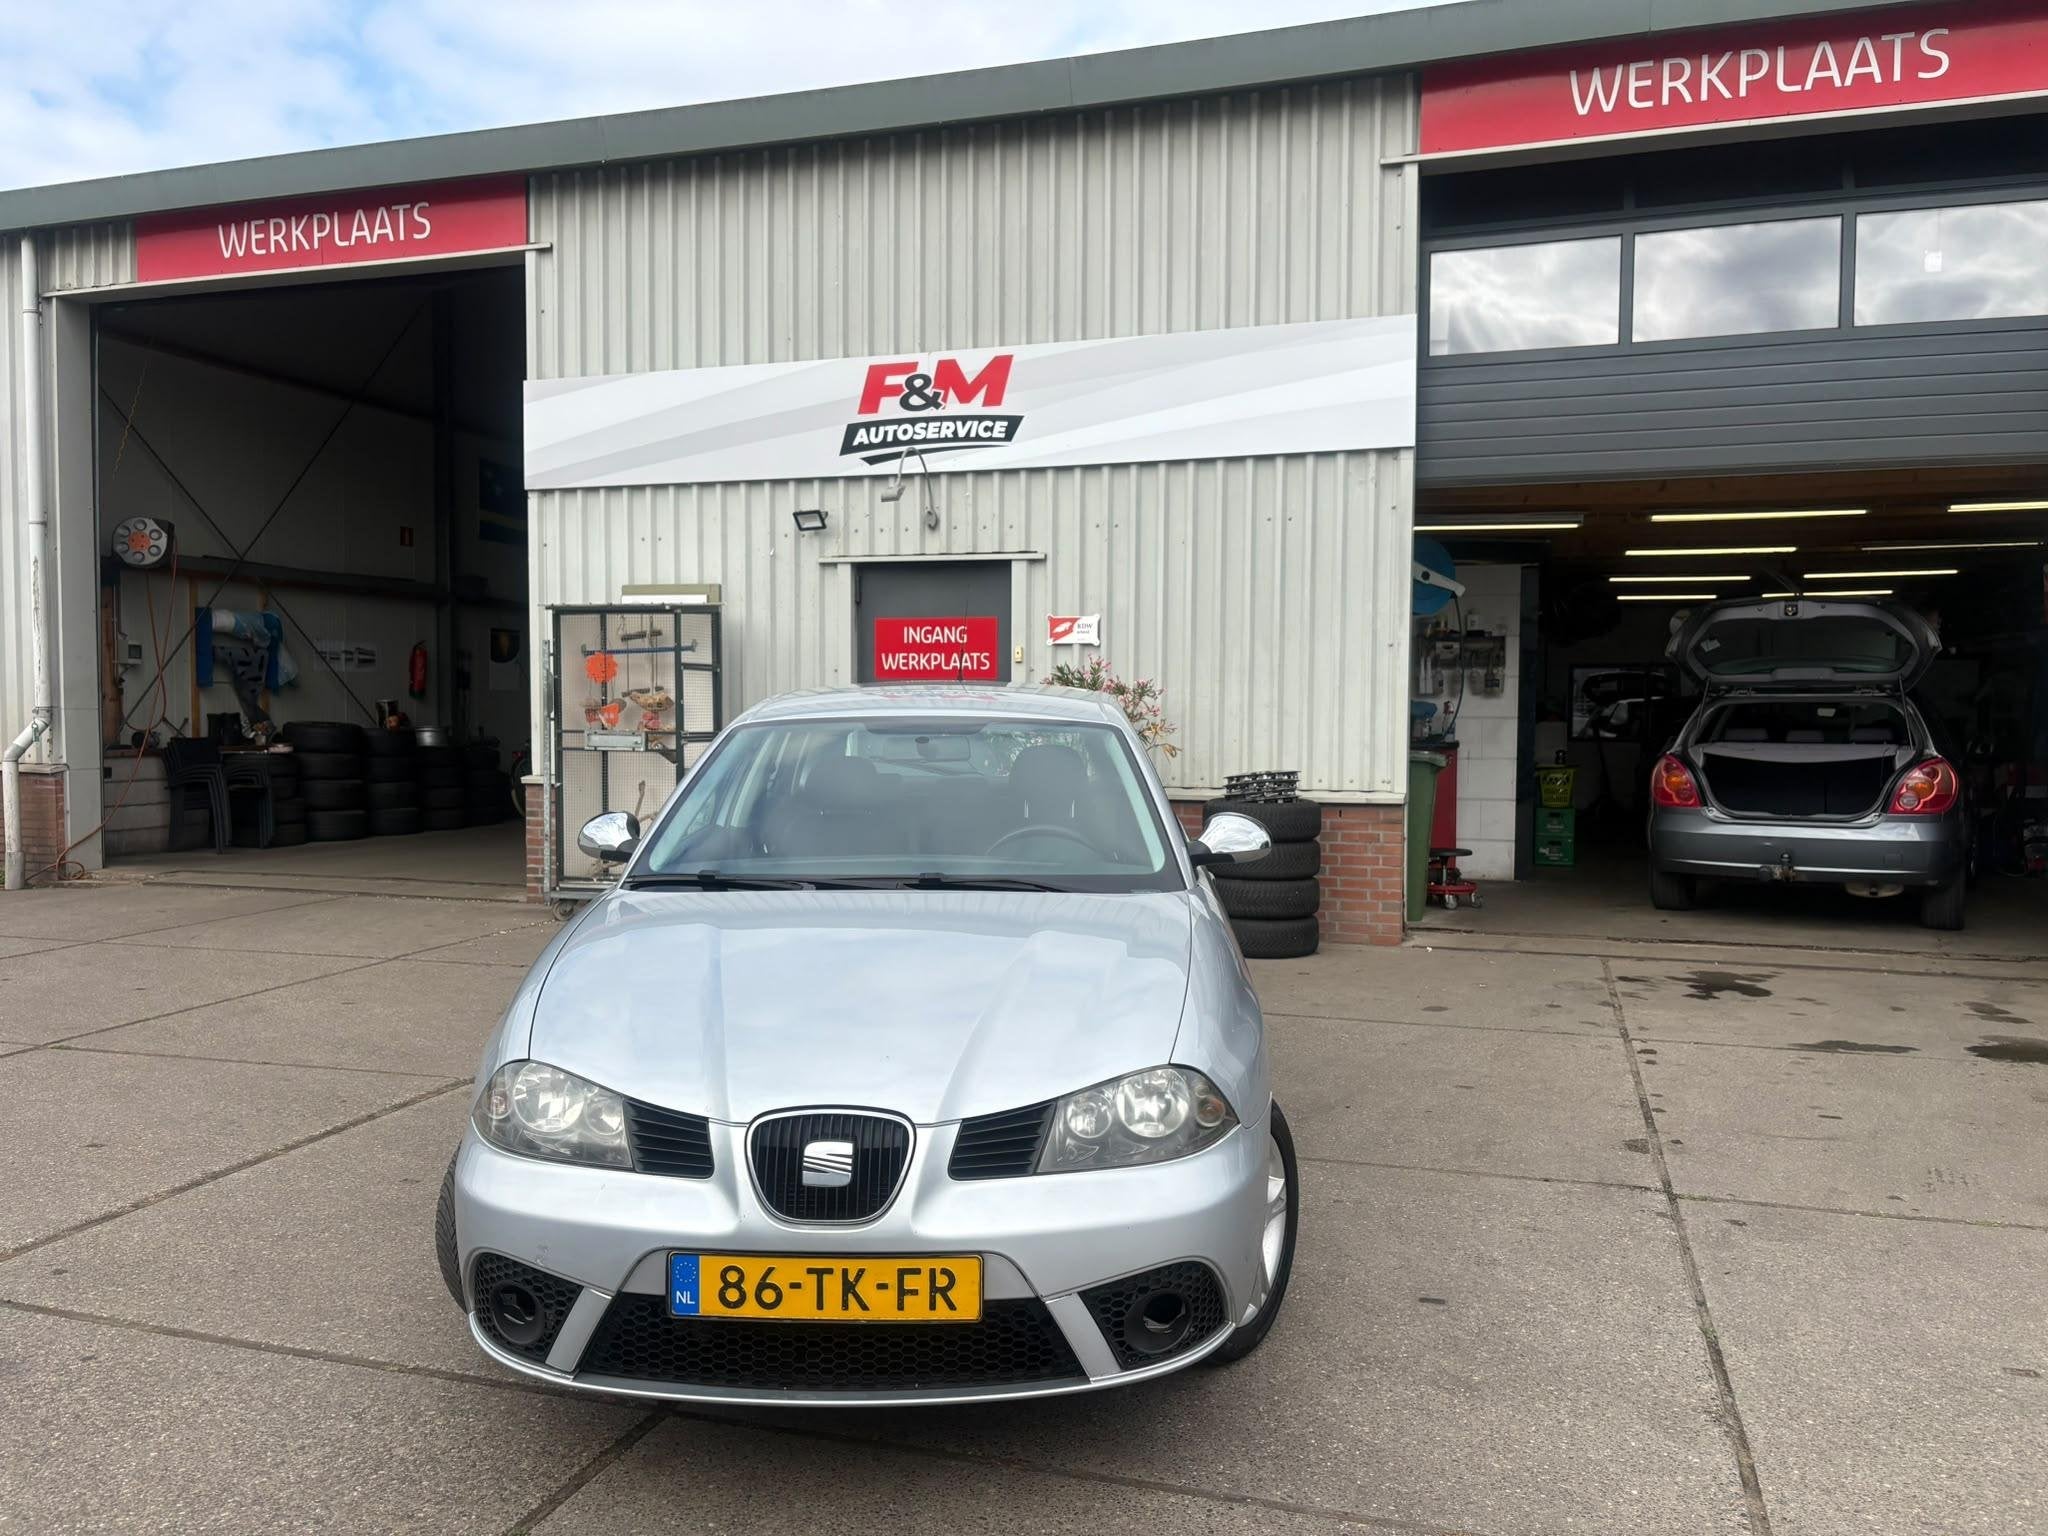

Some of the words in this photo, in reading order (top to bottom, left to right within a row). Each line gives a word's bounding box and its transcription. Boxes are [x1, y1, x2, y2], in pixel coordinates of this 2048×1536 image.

[1569, 28, 1950, 115] WERKPLAATS
[218, 202, 431, 259] WERKPLAATS
[857, 354, 1014, 414] F&M
[852, 420, 1008, 446] AUTOSERVICE
[903, 626, 968, 644] INGANG
[881, 652, 991, 671] WERKPLAATS
[676, 1290, 695, 1305] NL
[718, 1264, 957, 1312] 86-TK-FR
